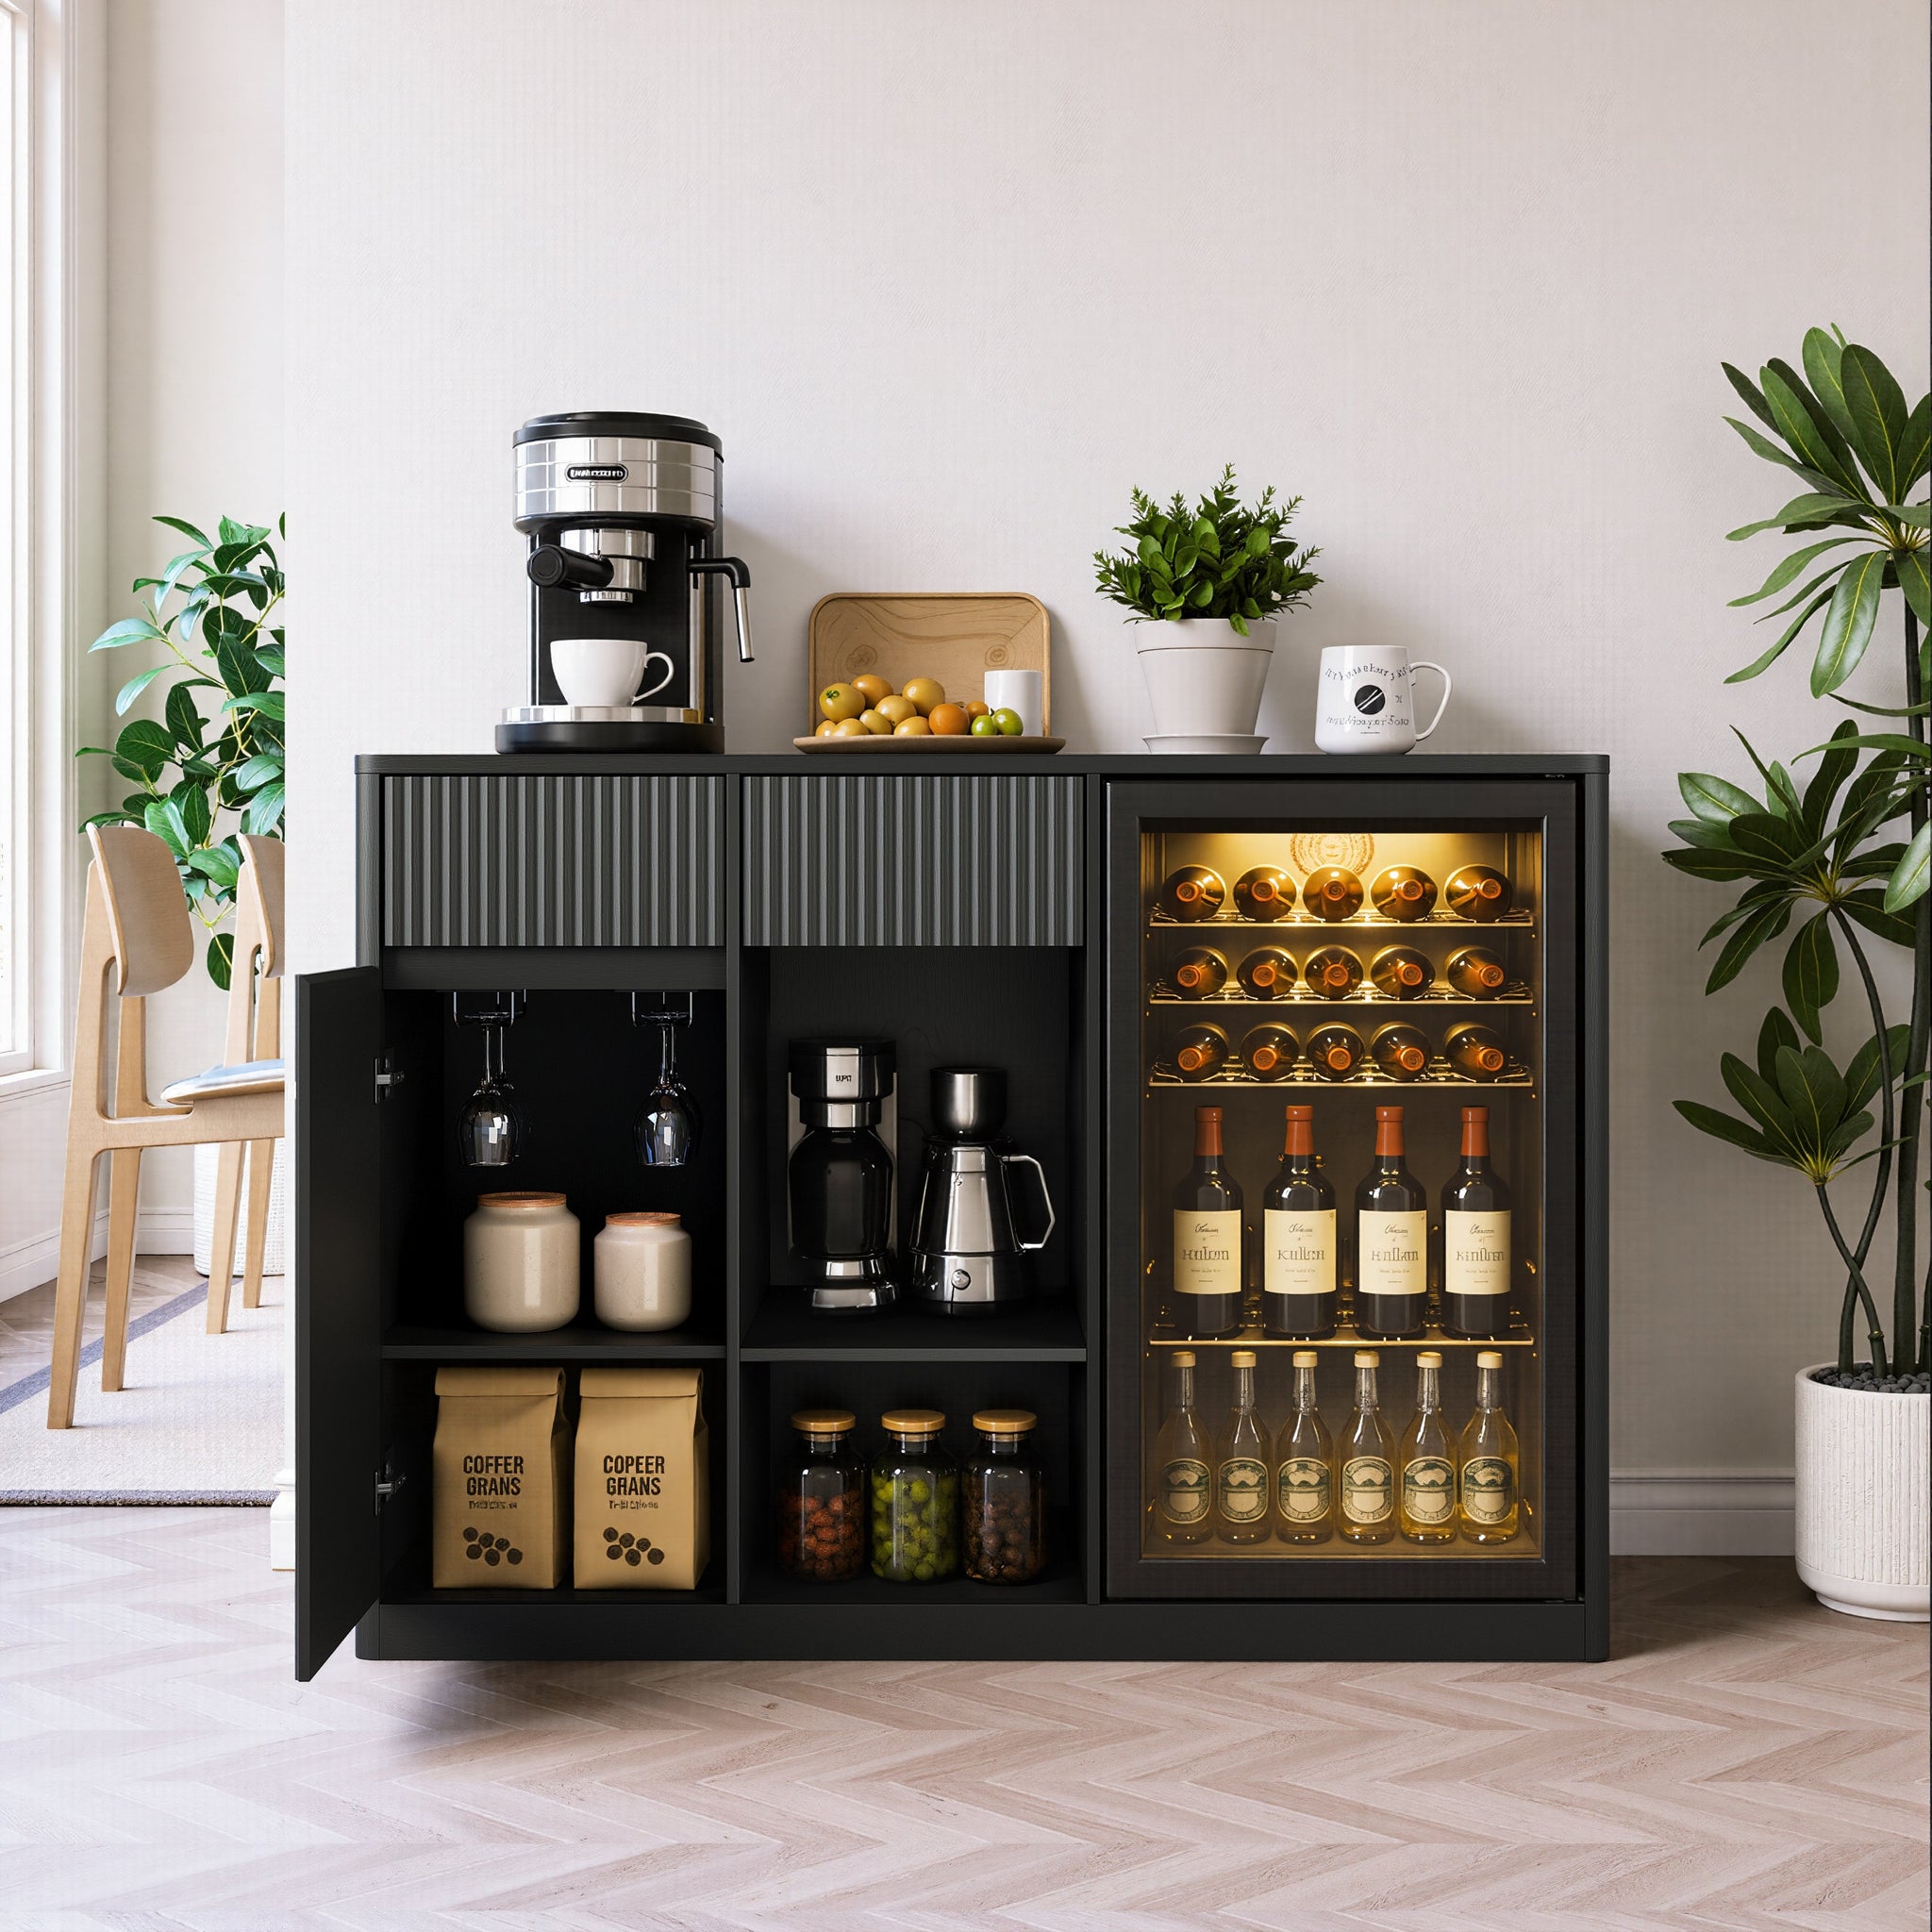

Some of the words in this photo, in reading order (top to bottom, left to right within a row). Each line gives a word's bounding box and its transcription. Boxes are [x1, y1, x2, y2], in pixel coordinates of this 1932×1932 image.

[463, 1455, 524, 1474] COFFER
[603, 1455, 665, 1474] COPEER
[467, 1476, 521, 1495] GRANS
